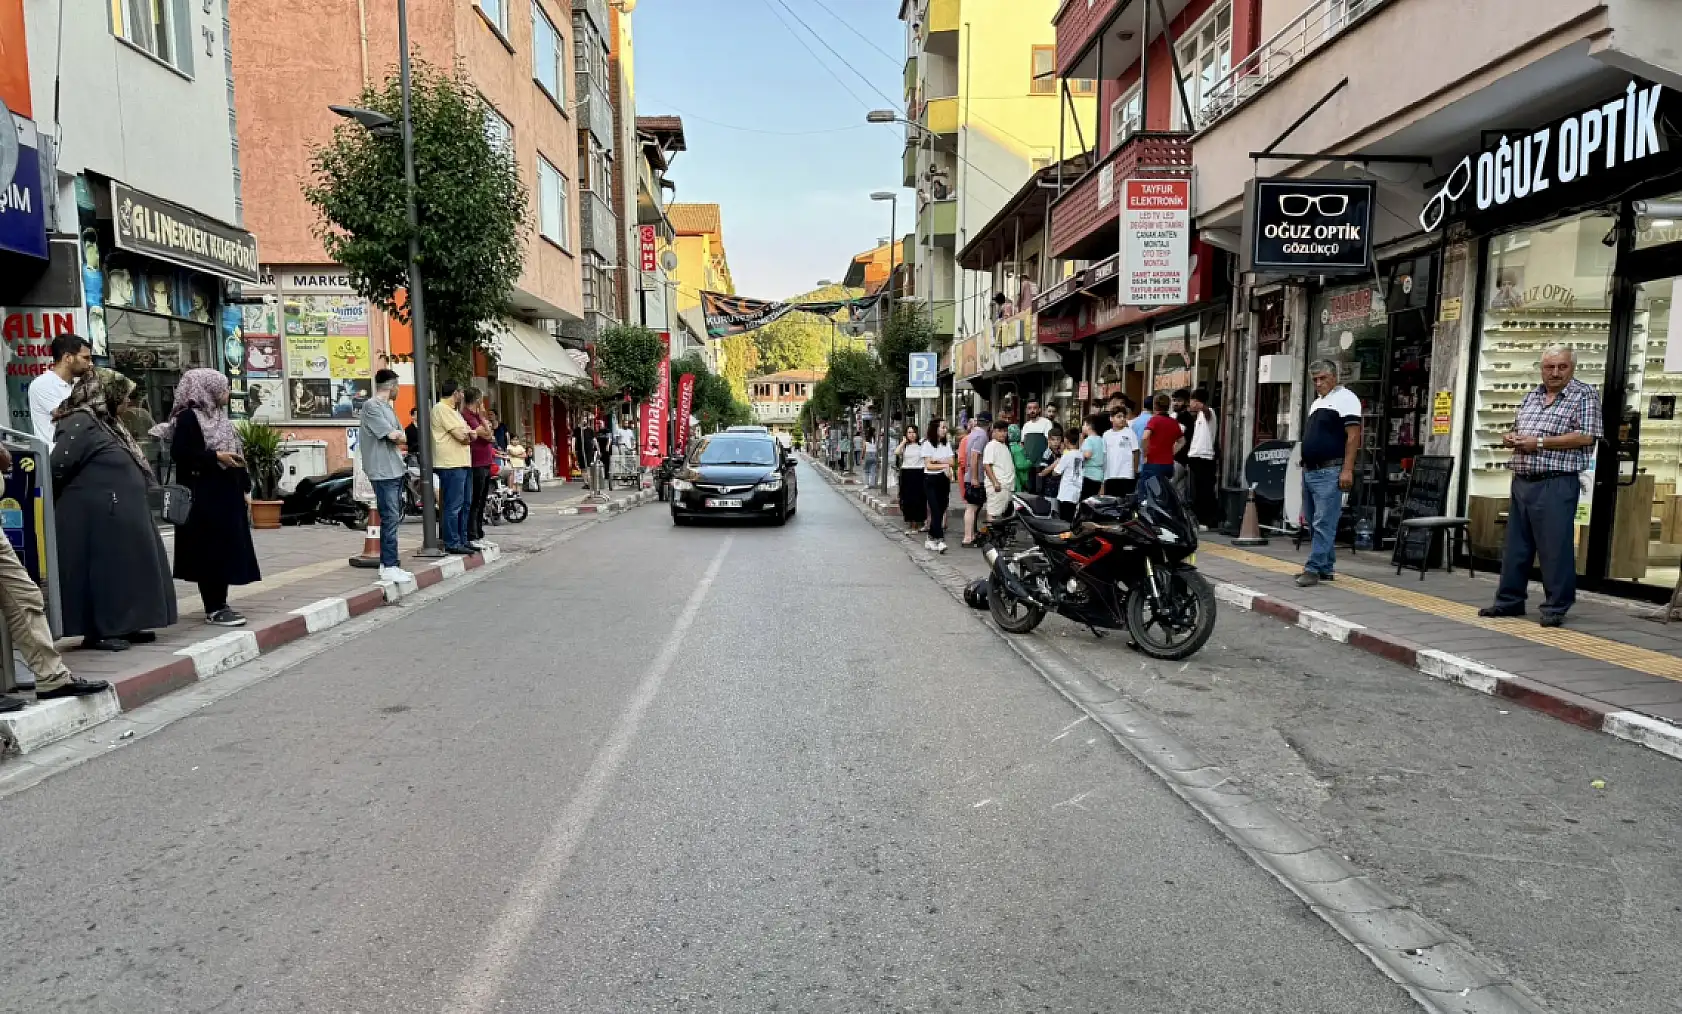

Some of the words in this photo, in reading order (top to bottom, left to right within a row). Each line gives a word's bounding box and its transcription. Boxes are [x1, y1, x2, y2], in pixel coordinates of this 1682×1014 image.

[1477, 135, 1550, 211] OĞUZ
[1558, 80, 1662, 183] OPTİK
[1141, 185, 1173, 194] TAYFUR
[1130, 195, 1184, 206] ELEKTRONİK
[1139, 212, 1151, 220] LED
[1152, 212, 1161, 220] TV
[1162, 212, 1175, 220] LED
[132, 204, 173, 247] ALIN
[171, 216, 208, 256] ERKEK
[1157, 231, 1177, 239] ANTEN
[1264, 221, 1312, 240] OĞUZ
[1314, 222, 1361, 240] OPTİK
[1142, 250, 1155, 258] OTO
[1282, 242, 1340, 257] GÖZLÜKÇÜ
[642, 243, 654, 271] MHP
[293, 275, 350, 286] MARKE
[3, 313, 75, 342] ALIN
[17, 344, 54, 357] ERKE
[12, 409, 31, 418] 053
